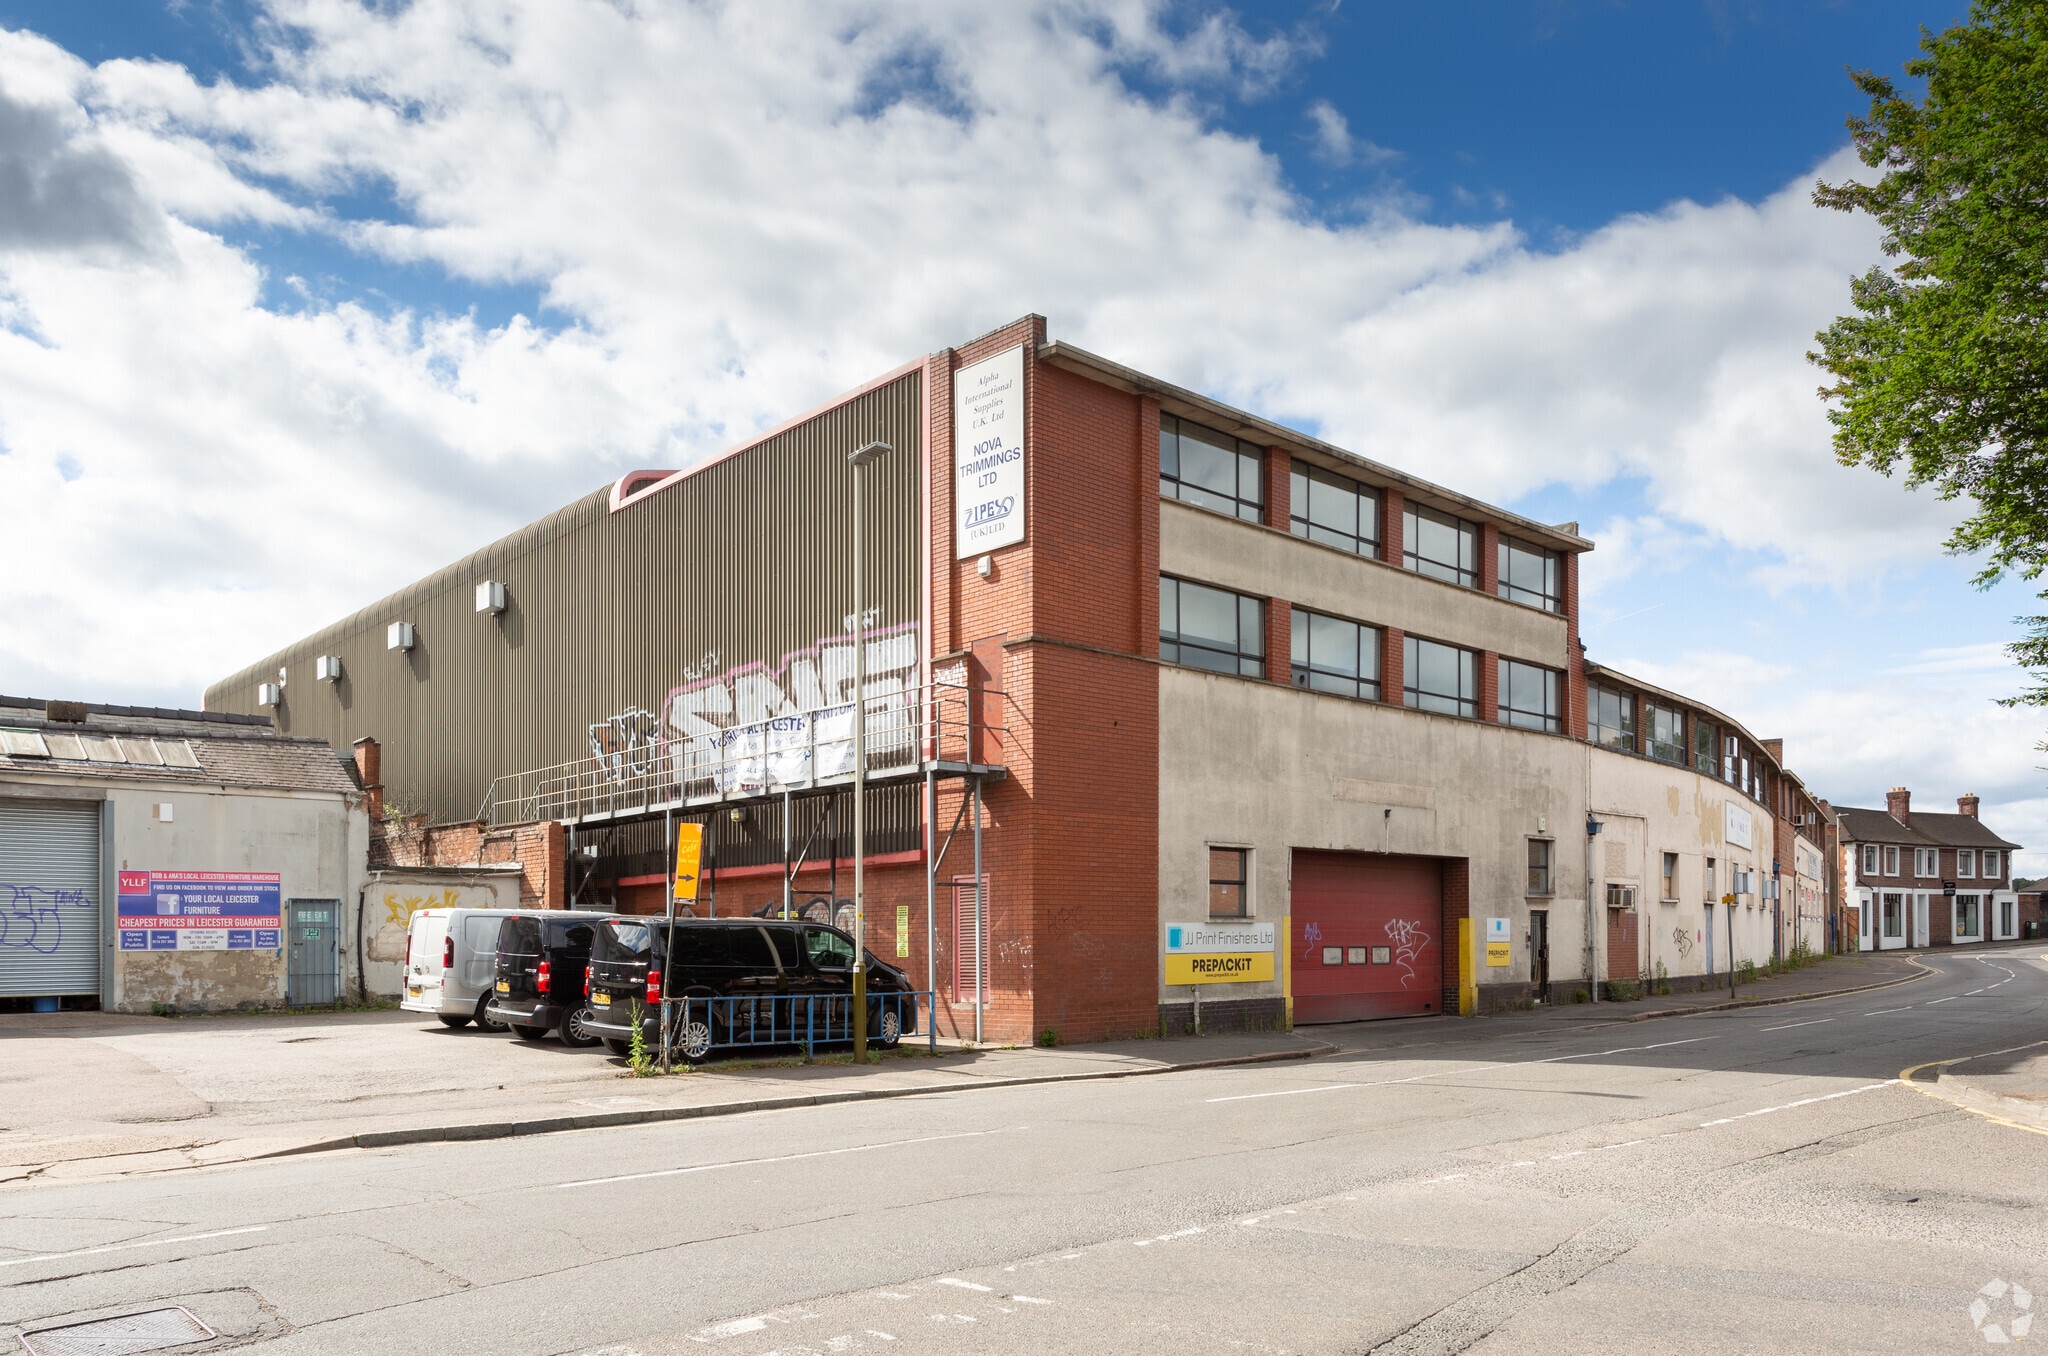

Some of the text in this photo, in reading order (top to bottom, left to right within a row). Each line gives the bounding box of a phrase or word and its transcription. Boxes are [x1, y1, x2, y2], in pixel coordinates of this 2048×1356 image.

[977, 372, 999, 387] Alpha
[964, 379, 1012, 405] International
[973, 398, 1003, 415] Supplies
[991, 410, 1004, 422] Ltd
[973, 436, 1002, 457] NOVA
[960, 447, 1021, 478] TRIMMINGS
[978, 471, 997, 488] LTD
[121, 878, 147, 887] YLLF
[183, 895, 259, 904] YOUR LOCAL LEICESTER
[184, 906, 221, 915] FURNITURE
[314, 911, 328, 919] EXT
[119, 918, 279, 927] CHEAPEST PRICES IN LEICESTER GUARANTEED
[1185, 931, 1273, 946] JJ Print Finishers Ltd
